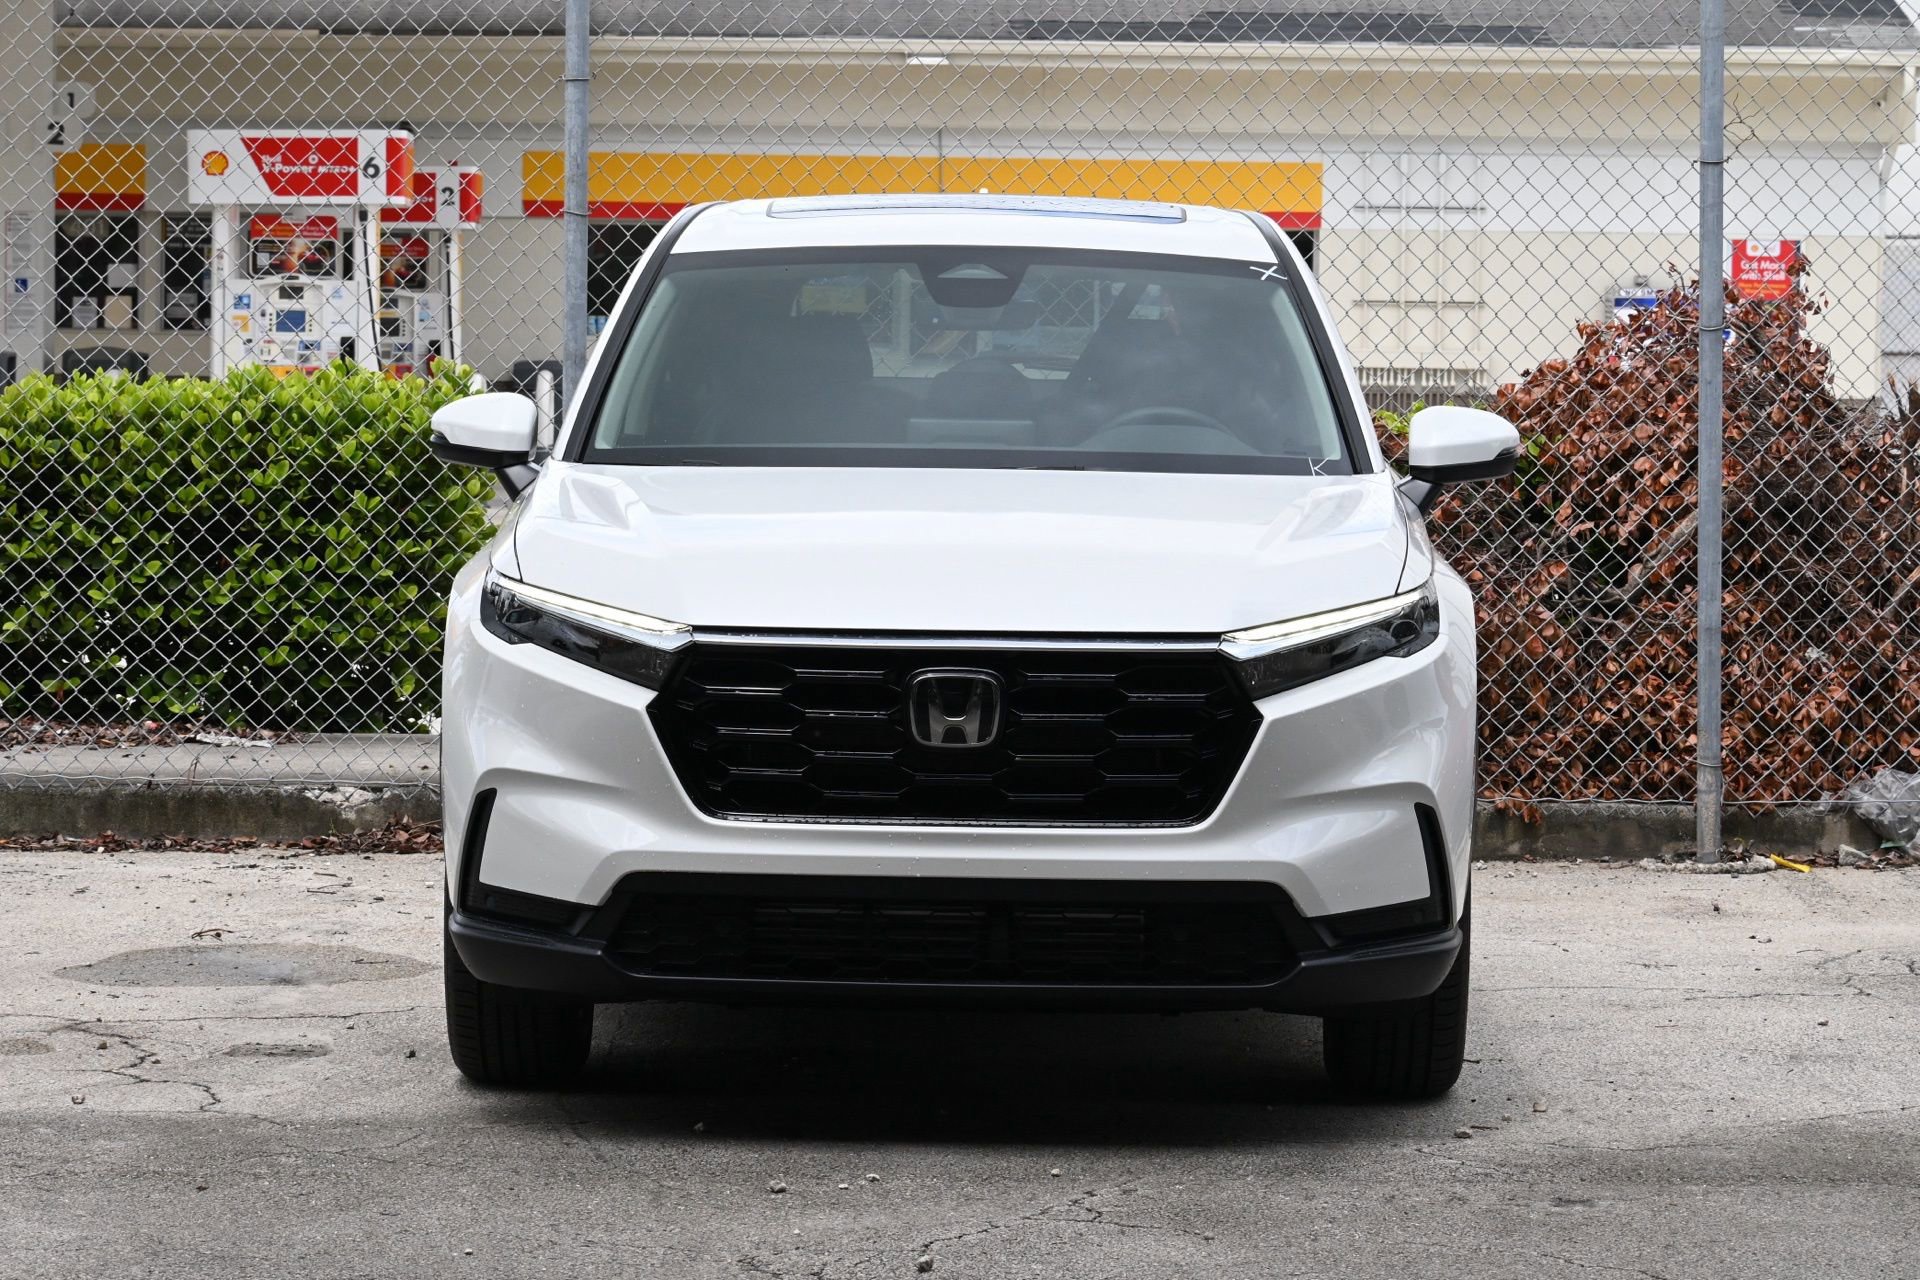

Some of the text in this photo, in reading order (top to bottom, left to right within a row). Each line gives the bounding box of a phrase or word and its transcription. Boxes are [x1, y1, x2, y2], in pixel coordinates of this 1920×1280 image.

[67, 92, 75, 111] 1
[47, 121, 65, 145] 2
[361, 156, 381, 179] 6
[441, 186, 456, 207] 2
[1763, 270, 1786, 281] Shell
